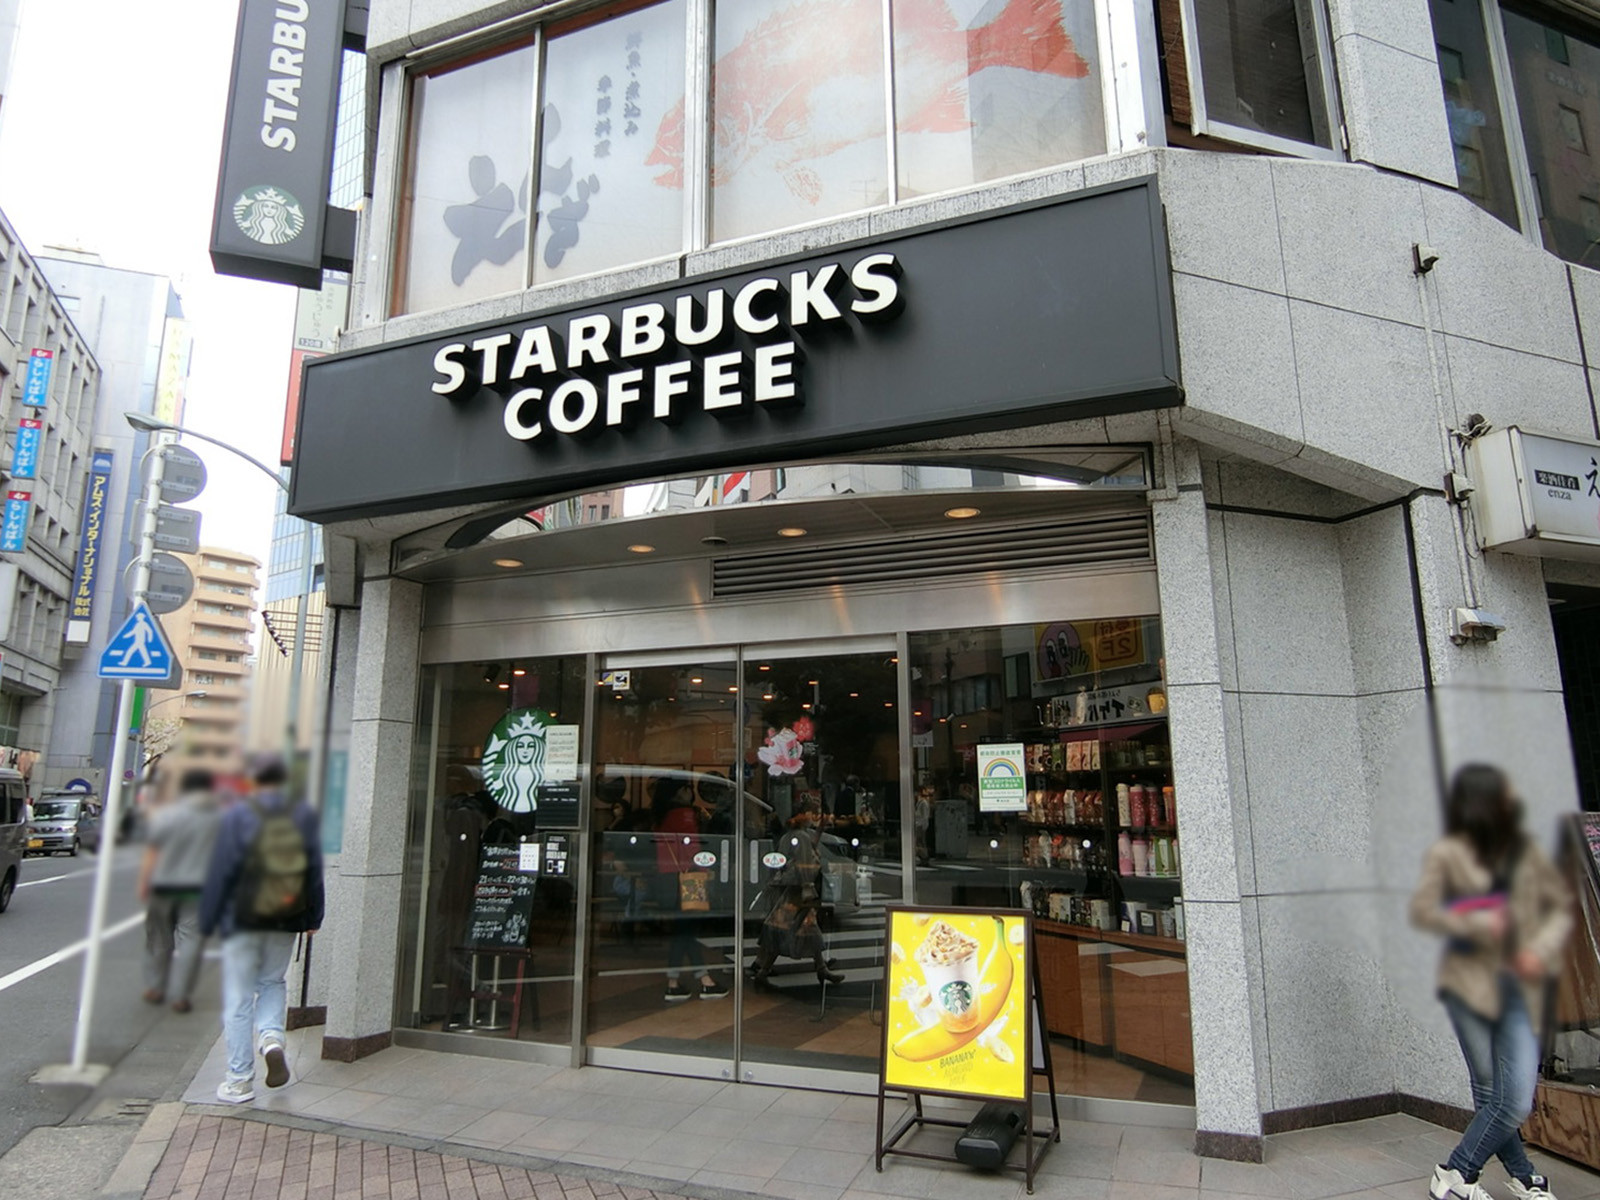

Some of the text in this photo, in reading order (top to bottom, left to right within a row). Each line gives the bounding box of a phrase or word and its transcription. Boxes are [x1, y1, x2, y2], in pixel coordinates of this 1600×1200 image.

[431, 253, 899, 395] STARBUCKS
[27, 358, 43, 405] らしんばん
[503, 341, 796, 441] COFFEE
[15, 429, 32, 476] らしんばん
[3, 501, 21, 550] らしんばん
